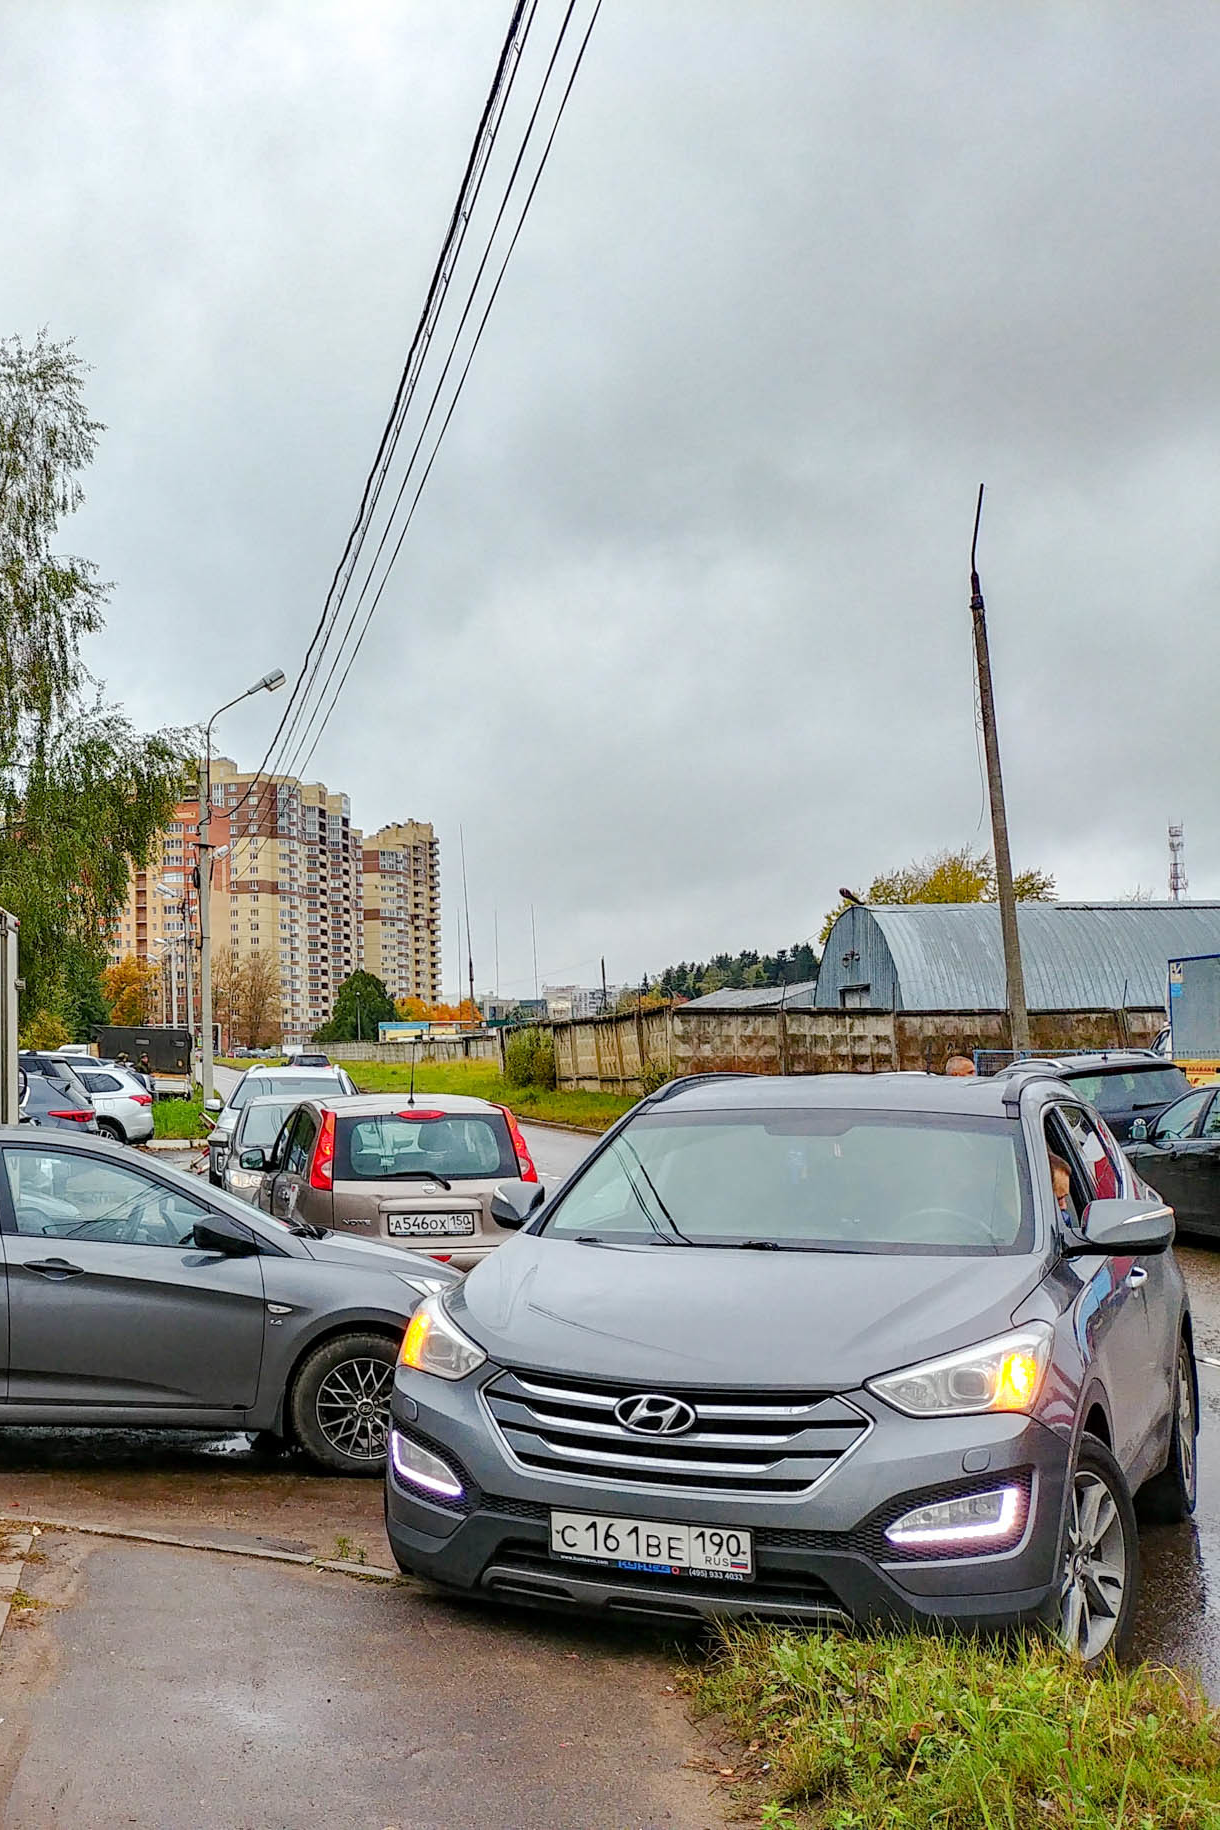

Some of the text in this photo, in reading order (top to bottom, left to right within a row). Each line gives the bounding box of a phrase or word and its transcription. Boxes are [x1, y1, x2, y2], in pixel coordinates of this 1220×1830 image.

[450, 1215, 470, 1226] 150
[560, 1520, 742, 1561] С161ВЕ 190
[705, 1556, 729, 1567] RUS
[688, 1567, 708, 1578] (495)
[709, 1570, 723, 1579] 933
